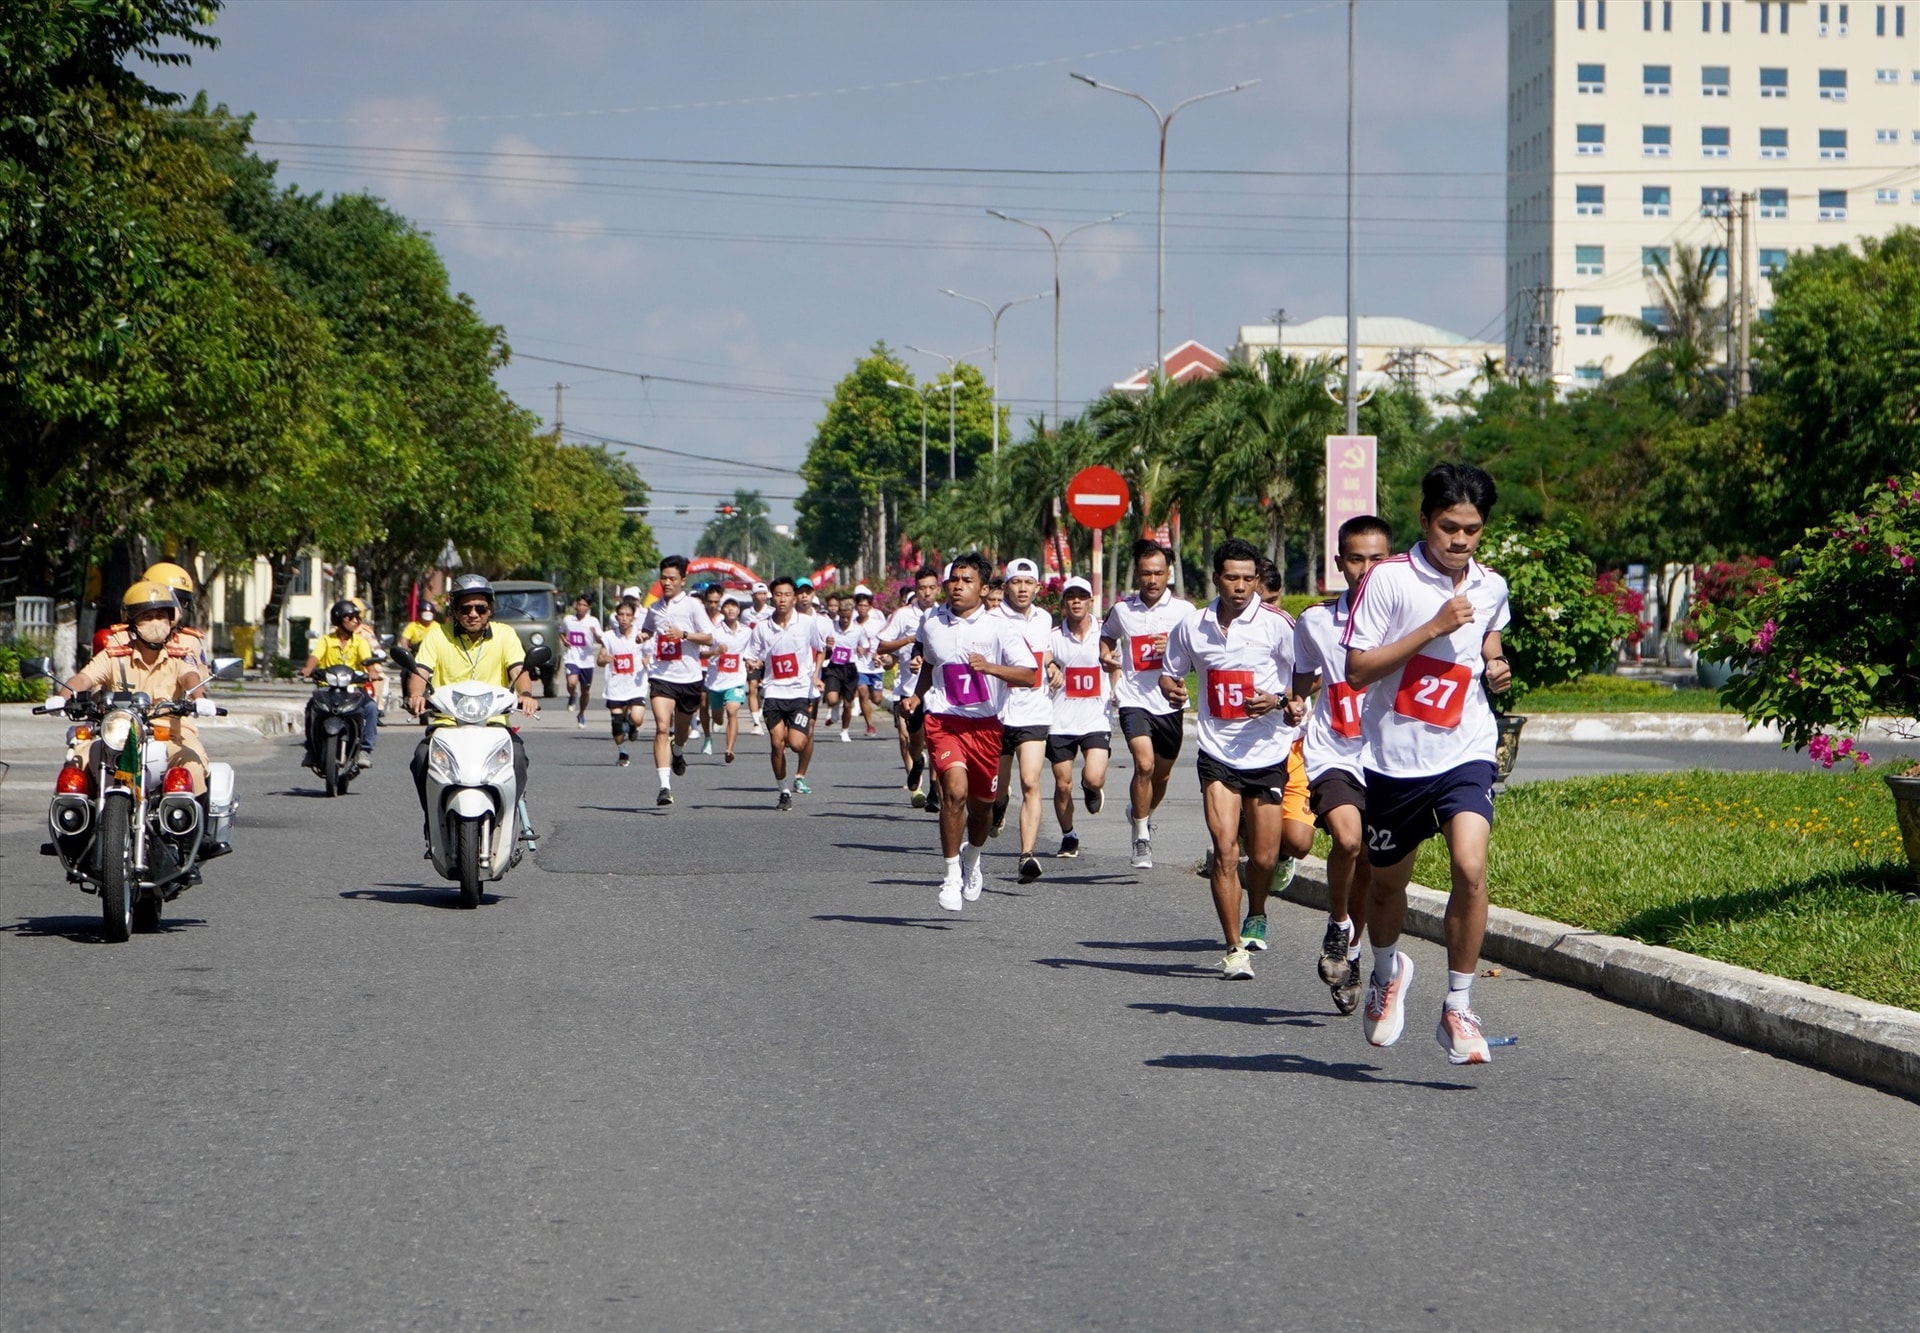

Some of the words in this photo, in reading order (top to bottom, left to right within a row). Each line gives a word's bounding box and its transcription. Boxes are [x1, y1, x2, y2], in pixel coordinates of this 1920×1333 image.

[661, 641, 676, 654] 23
[723, 658, 737, 668] 25
[836, 651, 848, 660] 12
[776, 660, 793, 673] 12
[958, 674, 972, 694] 7
[1073, 675, 1094, 690] 10
[1215, 683, 1243, 707] 15
[1413, 675, 1458, 710] 27
[1367, 824, 1397, 851] 22
